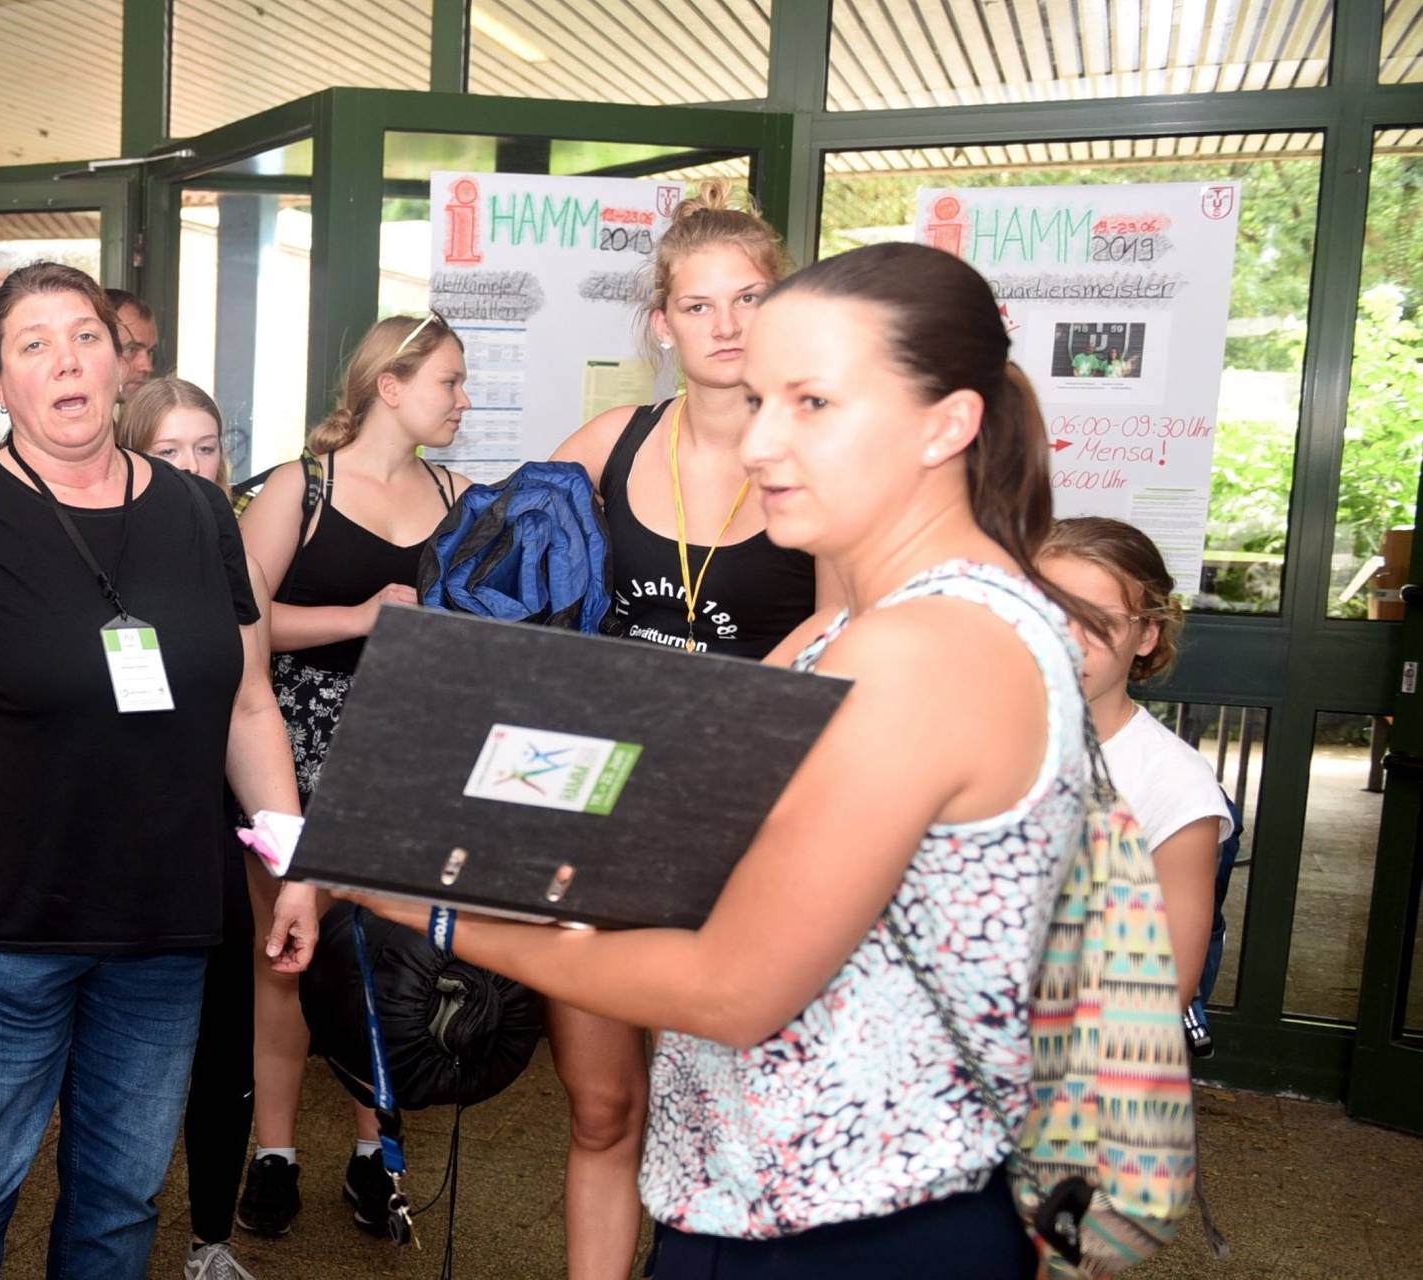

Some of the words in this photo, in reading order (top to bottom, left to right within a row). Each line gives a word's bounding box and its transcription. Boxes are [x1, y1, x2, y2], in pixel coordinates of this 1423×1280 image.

[445, 179, 483, 263] i
[489, 194, 599, 249] HAMM
[599, 227, 653, 255] 2019
[972, 207, 1094, 264] HAMM
[1091, 235, 1154, 263] 2019
[1186, 416, 1212, 438] Uhr
[1101, 468, 1127, 489] Uhr
